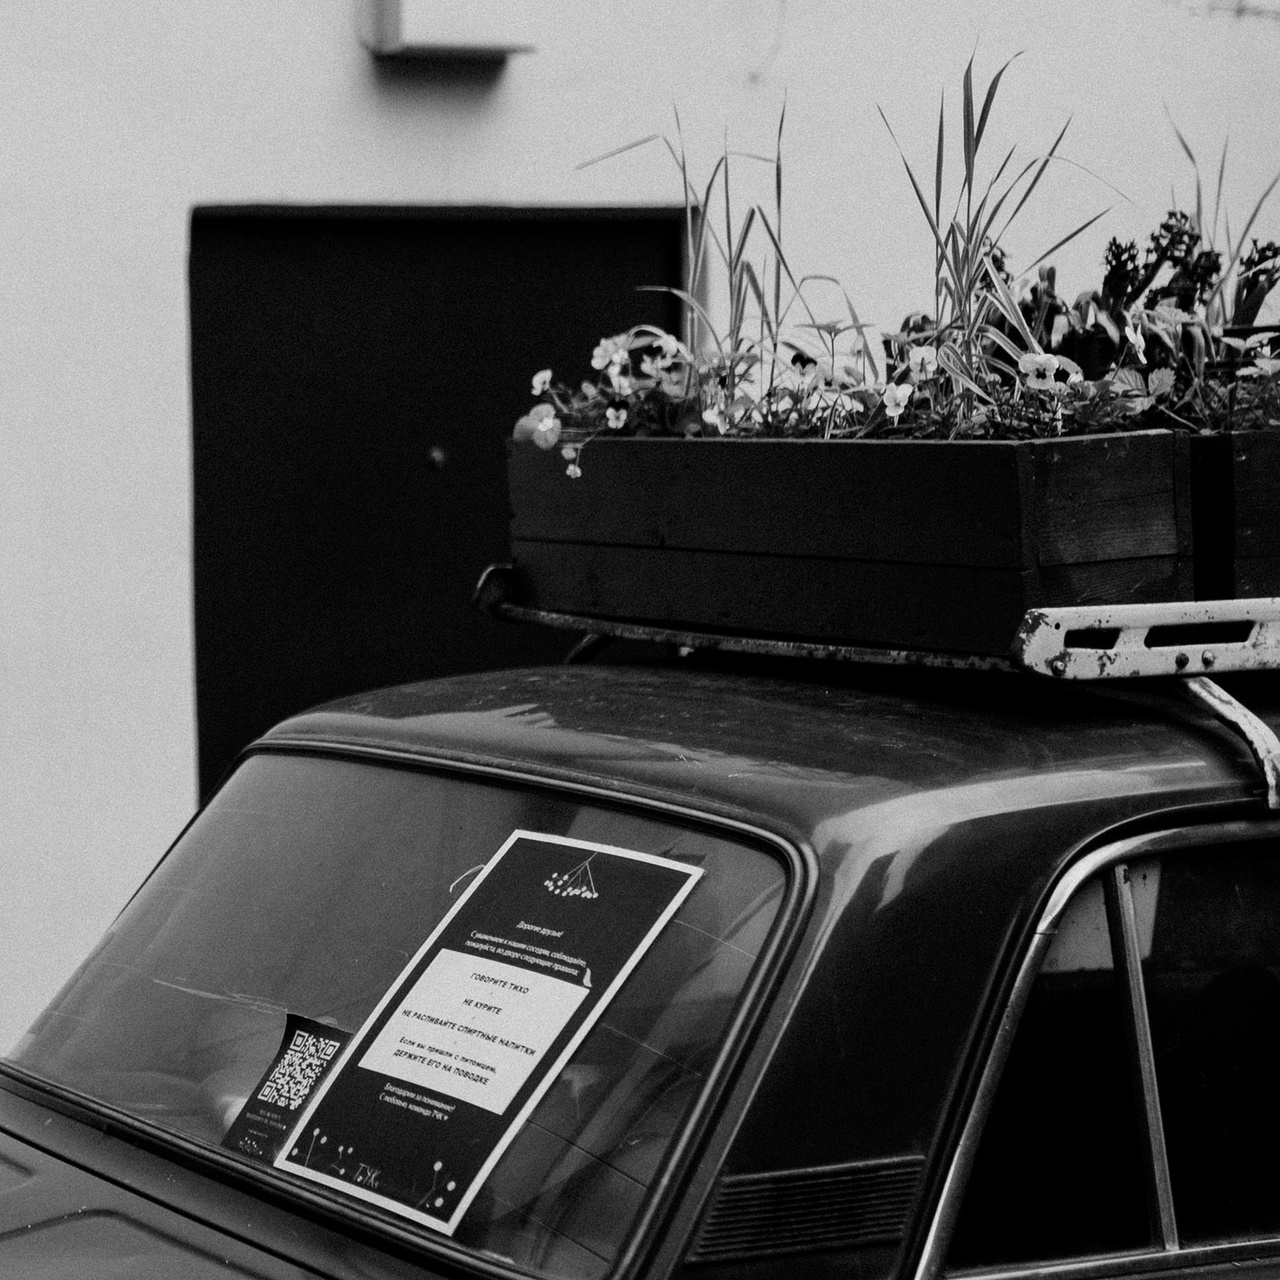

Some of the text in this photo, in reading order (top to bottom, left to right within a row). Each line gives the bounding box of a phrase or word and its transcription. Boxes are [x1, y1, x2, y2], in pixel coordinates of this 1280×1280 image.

[471, 973, 529, 994] ГОВОРИТЕ ТИХО
[474, 1002, 502, 1014] КУРИТЕ
[413, 1012, 457, 1029] РАСПИВАЙТЕ
[457, 1025, 498, 1042] СПИРТНЫЕ
[500, 1039, 536, 1055] НАПИТКИ
[394, 1049, 427, 1064] ДЕРЖИТЕ
[427, 1059, 441, 1068] ЕГО
[454, 1068, 489, 1085] ПОВОДКЕ
[400, 1037, 415, 1045] Если
[428, 1046, 453, 1057] пришли
[461, 1057, 495, 1073] питомцем,
